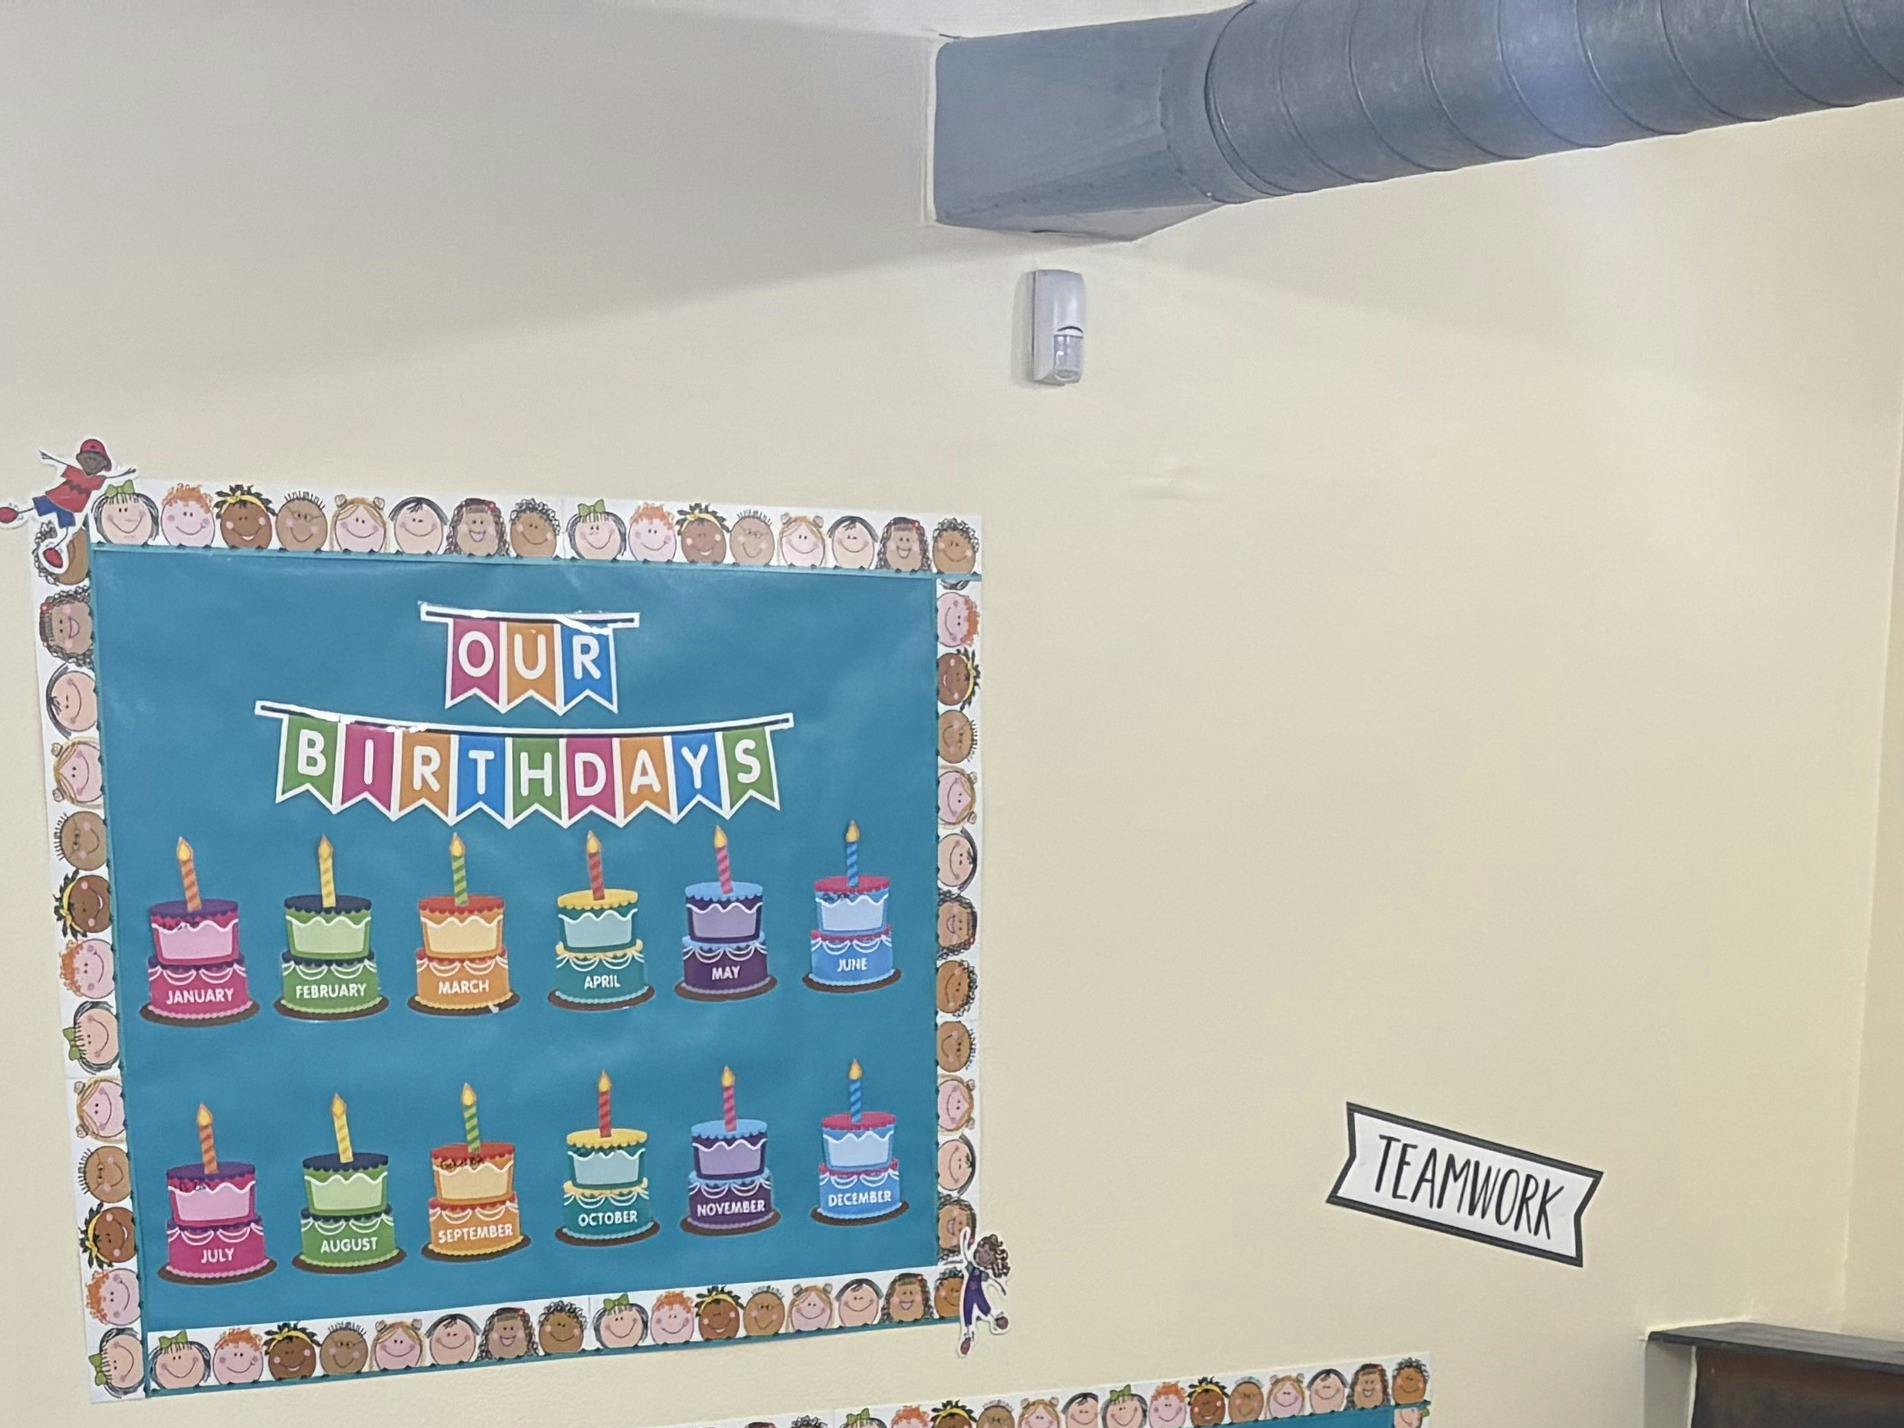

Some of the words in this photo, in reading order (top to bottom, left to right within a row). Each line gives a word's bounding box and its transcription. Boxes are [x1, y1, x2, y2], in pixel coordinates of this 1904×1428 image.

[459, 631, 600, 679] OUR
[298, 729, 760, 796] BIRTHDAYS
[838, 958, 867, 971] JUNE
[712, 966, 739, 980] MAY
[439, 980, 489, 994] MARCH
[585, 975, 620, 989] APRIL
[167, 988, 233, 1004] JANUARY
[296, 984, 366, 998] FEBRUARY
[1375, 1134, 1565, 1240] TEAMWORK
[829, 1191, 891, 1206] DECEMBER
[698, 1200, 764, 1216] NOVEMBER
[579, 1210, 637, 1226] OCTOBER
[439, 1224, 513, 1243] SEPTEMBER
[321, 1237, 377, 1252] AUGUST
[201, 1248, 234, 1263] JULY
